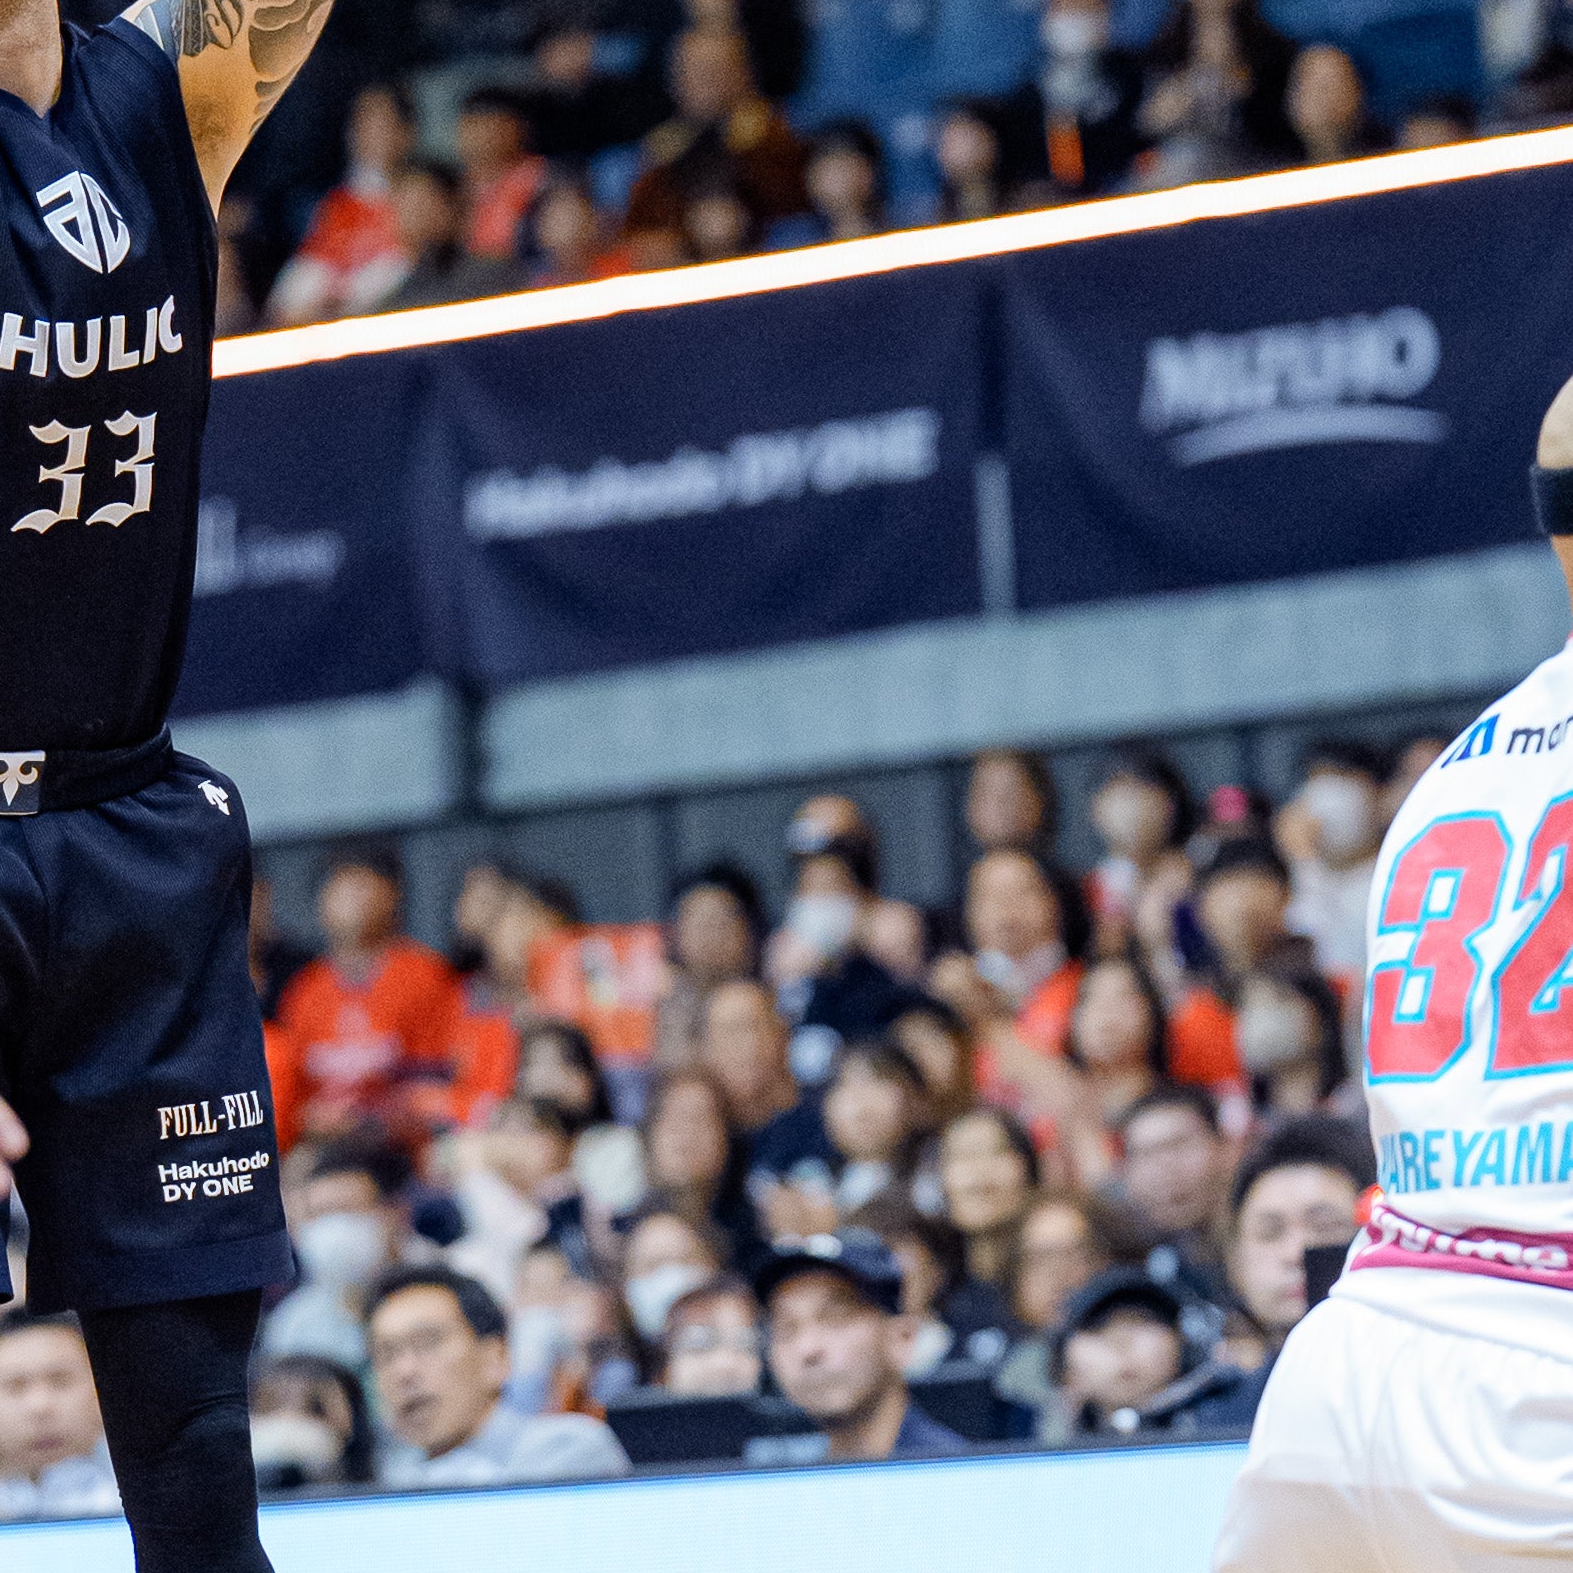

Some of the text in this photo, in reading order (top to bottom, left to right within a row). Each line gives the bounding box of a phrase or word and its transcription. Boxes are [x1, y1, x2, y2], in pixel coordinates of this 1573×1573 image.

[11, 409, 158, 534] 33
[1363, 791, 1573, 1086] 32
[157, 1090, 264, 1140] FULL-FILL
[158, 1150, 270, 1183] Hakuhodo
[162, 1174, 254, 1203] DY ONE
